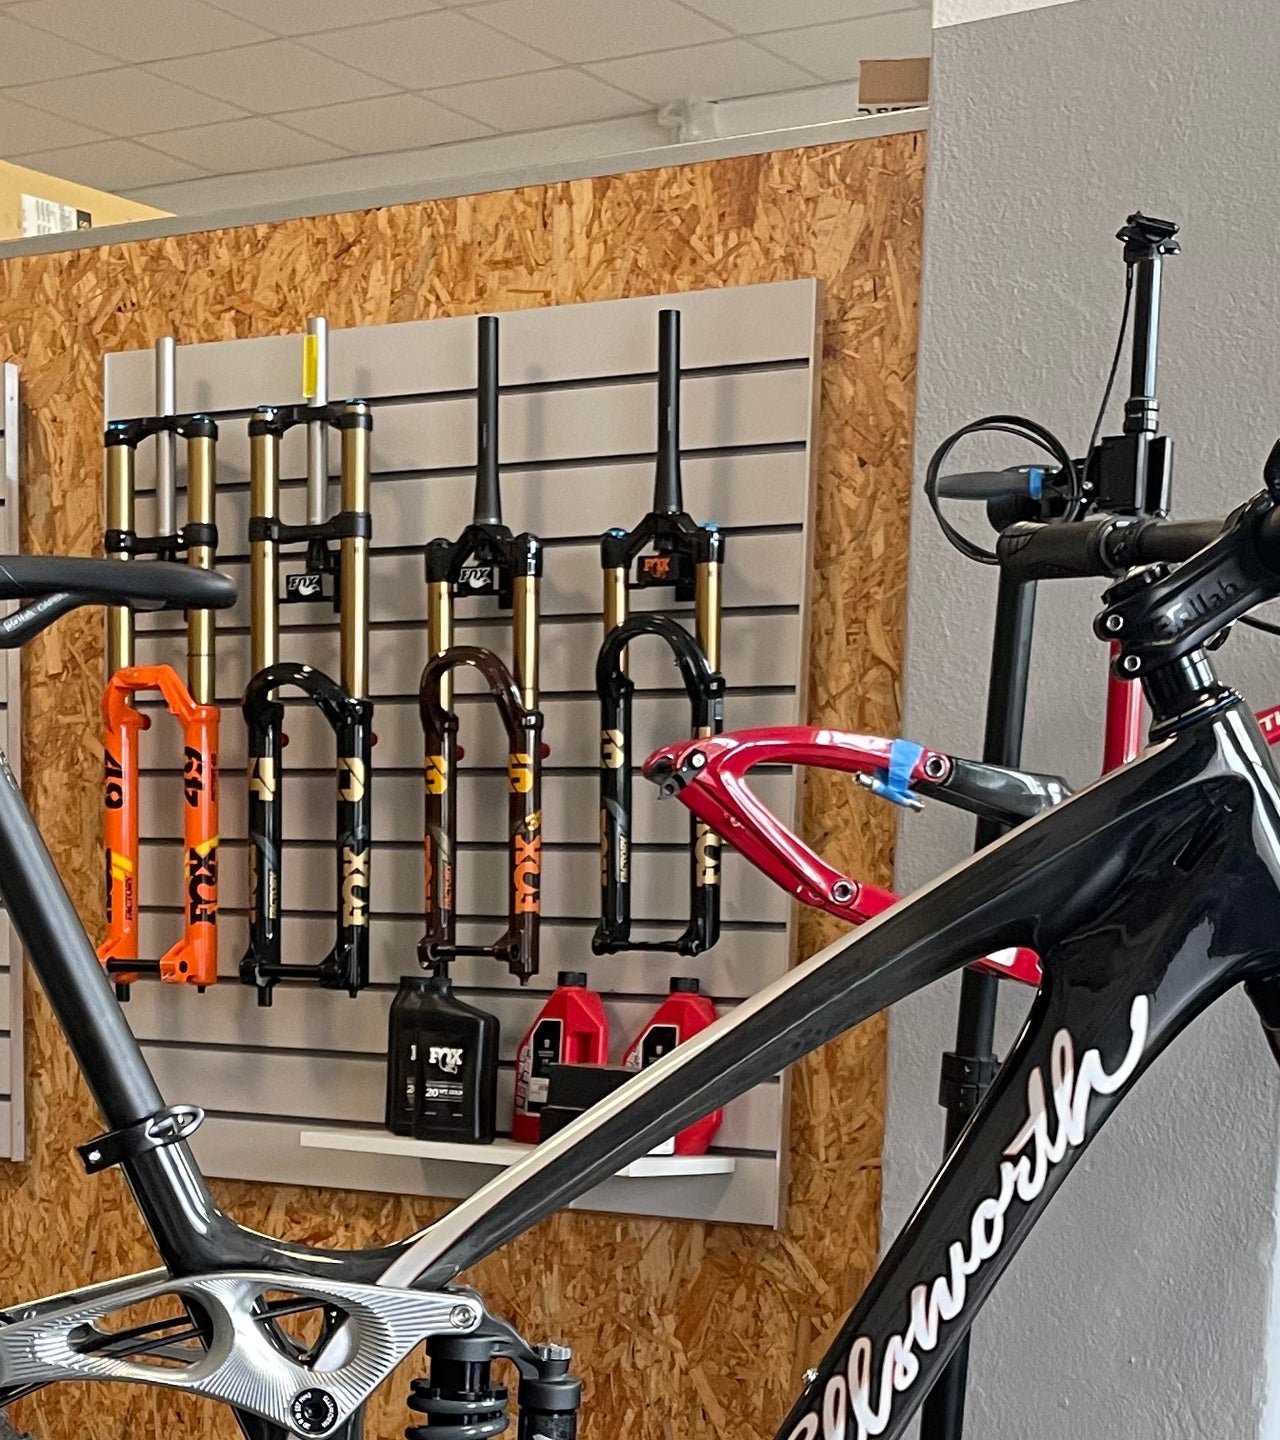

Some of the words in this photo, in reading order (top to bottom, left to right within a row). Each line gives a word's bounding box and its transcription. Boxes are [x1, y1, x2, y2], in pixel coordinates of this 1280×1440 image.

[189, 847, 218, 926] FOX
[342, 846, 370, 928] FOX
[514, 834, 541, 915] FOX
[425, 1087, 439, 1098] 20
[428, 1046, 464, 1075] FOX
